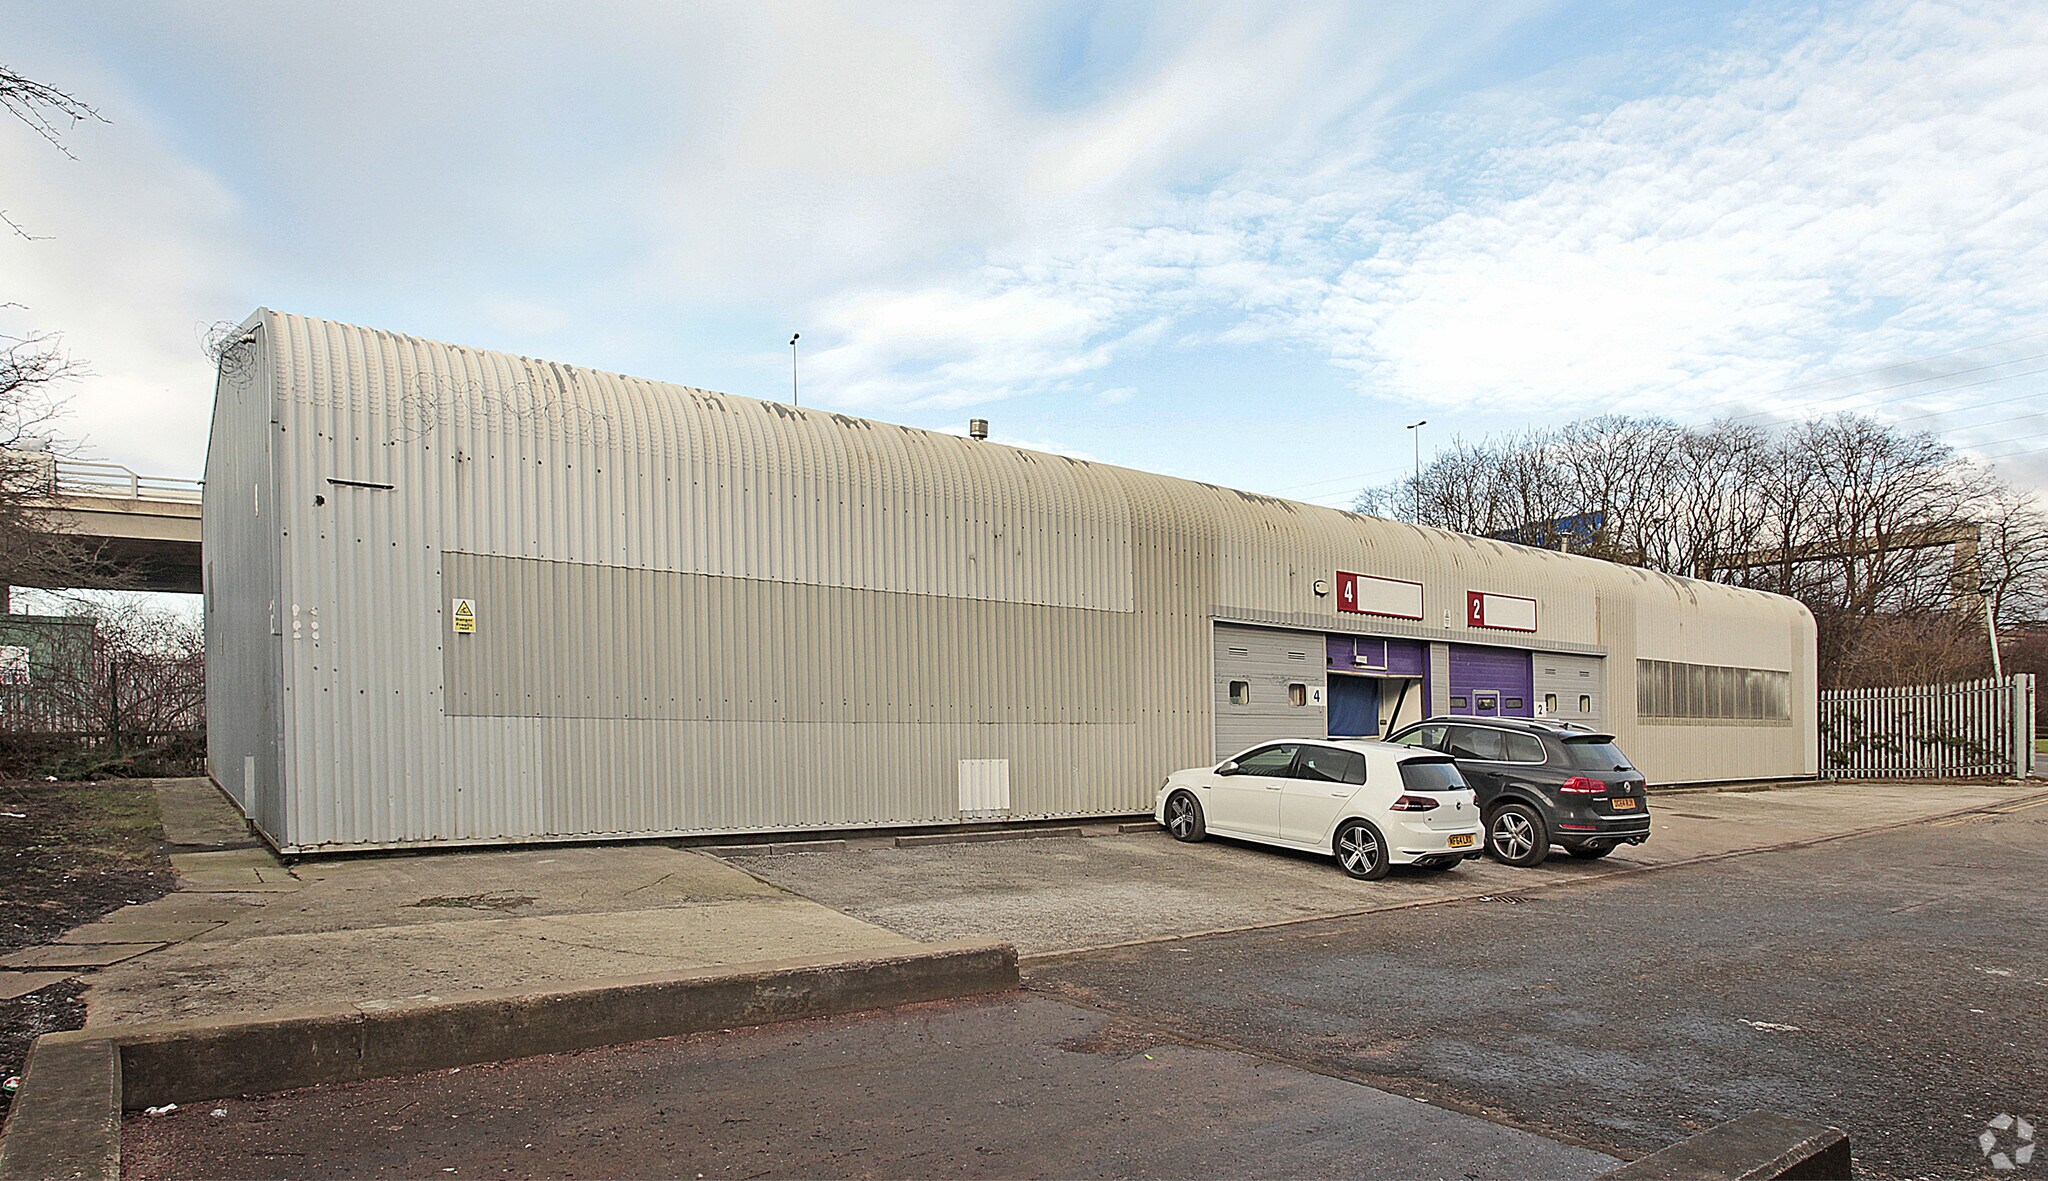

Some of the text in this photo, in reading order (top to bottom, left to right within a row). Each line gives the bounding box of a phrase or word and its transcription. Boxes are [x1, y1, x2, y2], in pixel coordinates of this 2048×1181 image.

[1344, 580, 1353, 603] 4
[1473, 598, 1481, 619] 2
[1313, 690, 1320, 703] 4
[1537, 704, 1543, 715] 2
